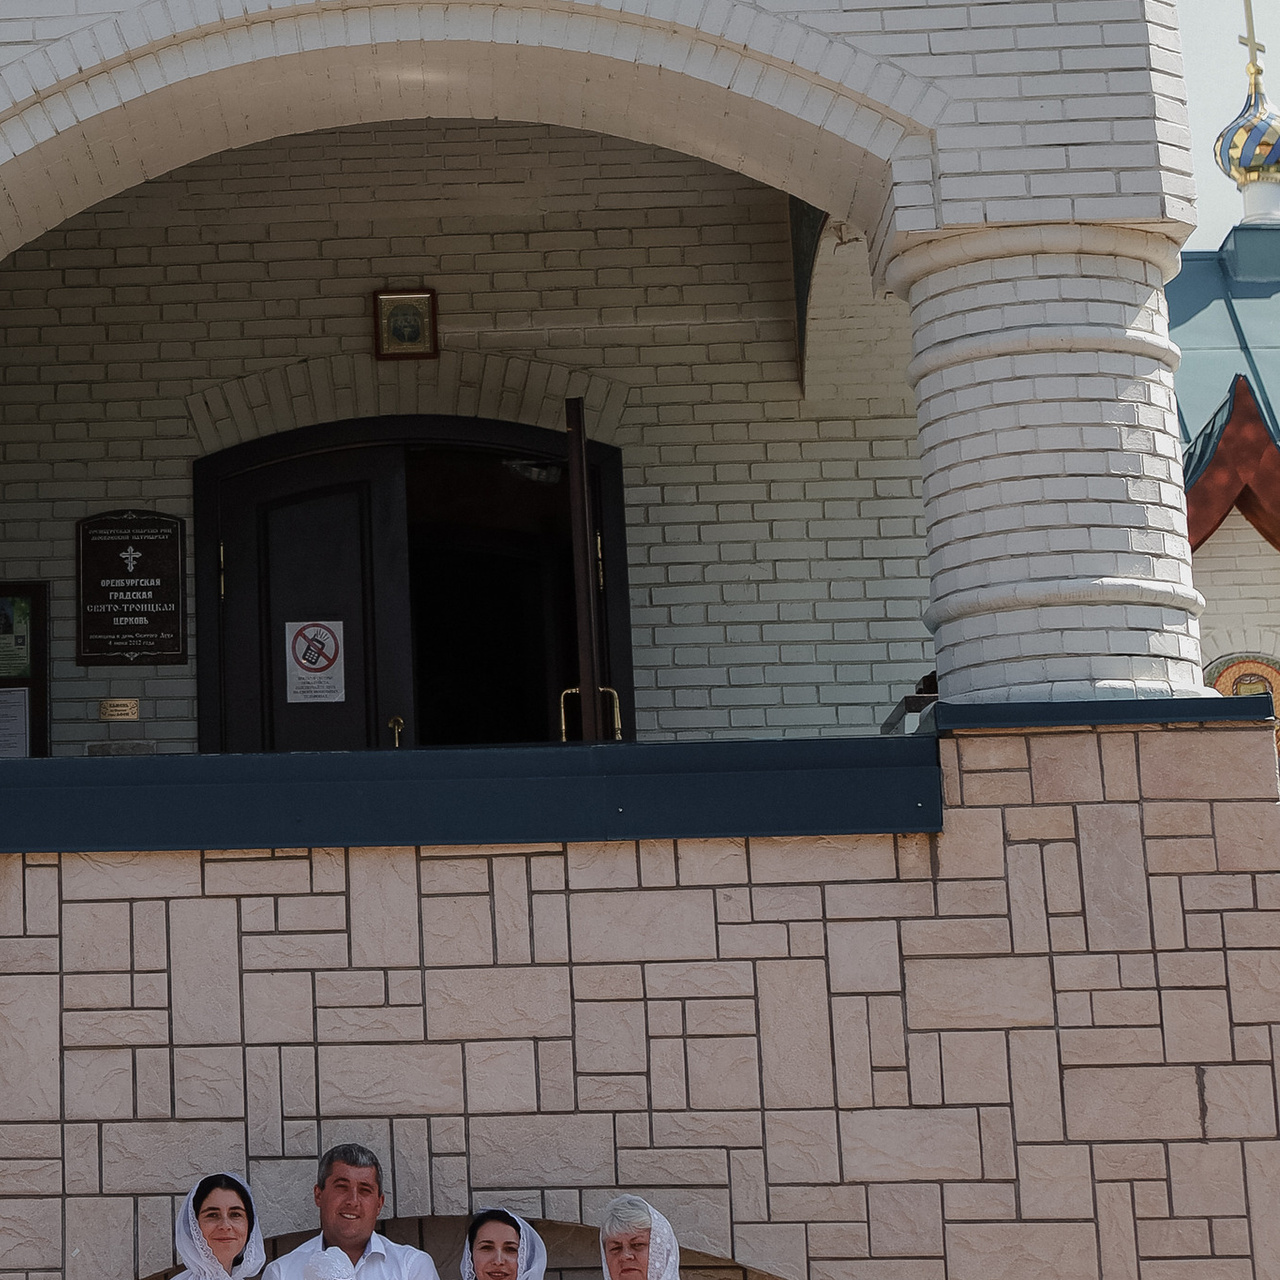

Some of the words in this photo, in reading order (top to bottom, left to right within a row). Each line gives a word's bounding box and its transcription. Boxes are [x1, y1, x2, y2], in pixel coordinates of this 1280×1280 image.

[100, 578, 161, 587] ОРЕНБУРГСКАЯ
[109, 591, 153, 600] ГРАДСКАЯ
[86, 603, 175, 613] СВЯТО-ТРОИЦКАЯ
[113, 616, 149, 625] ЦЕРКОВЬ
